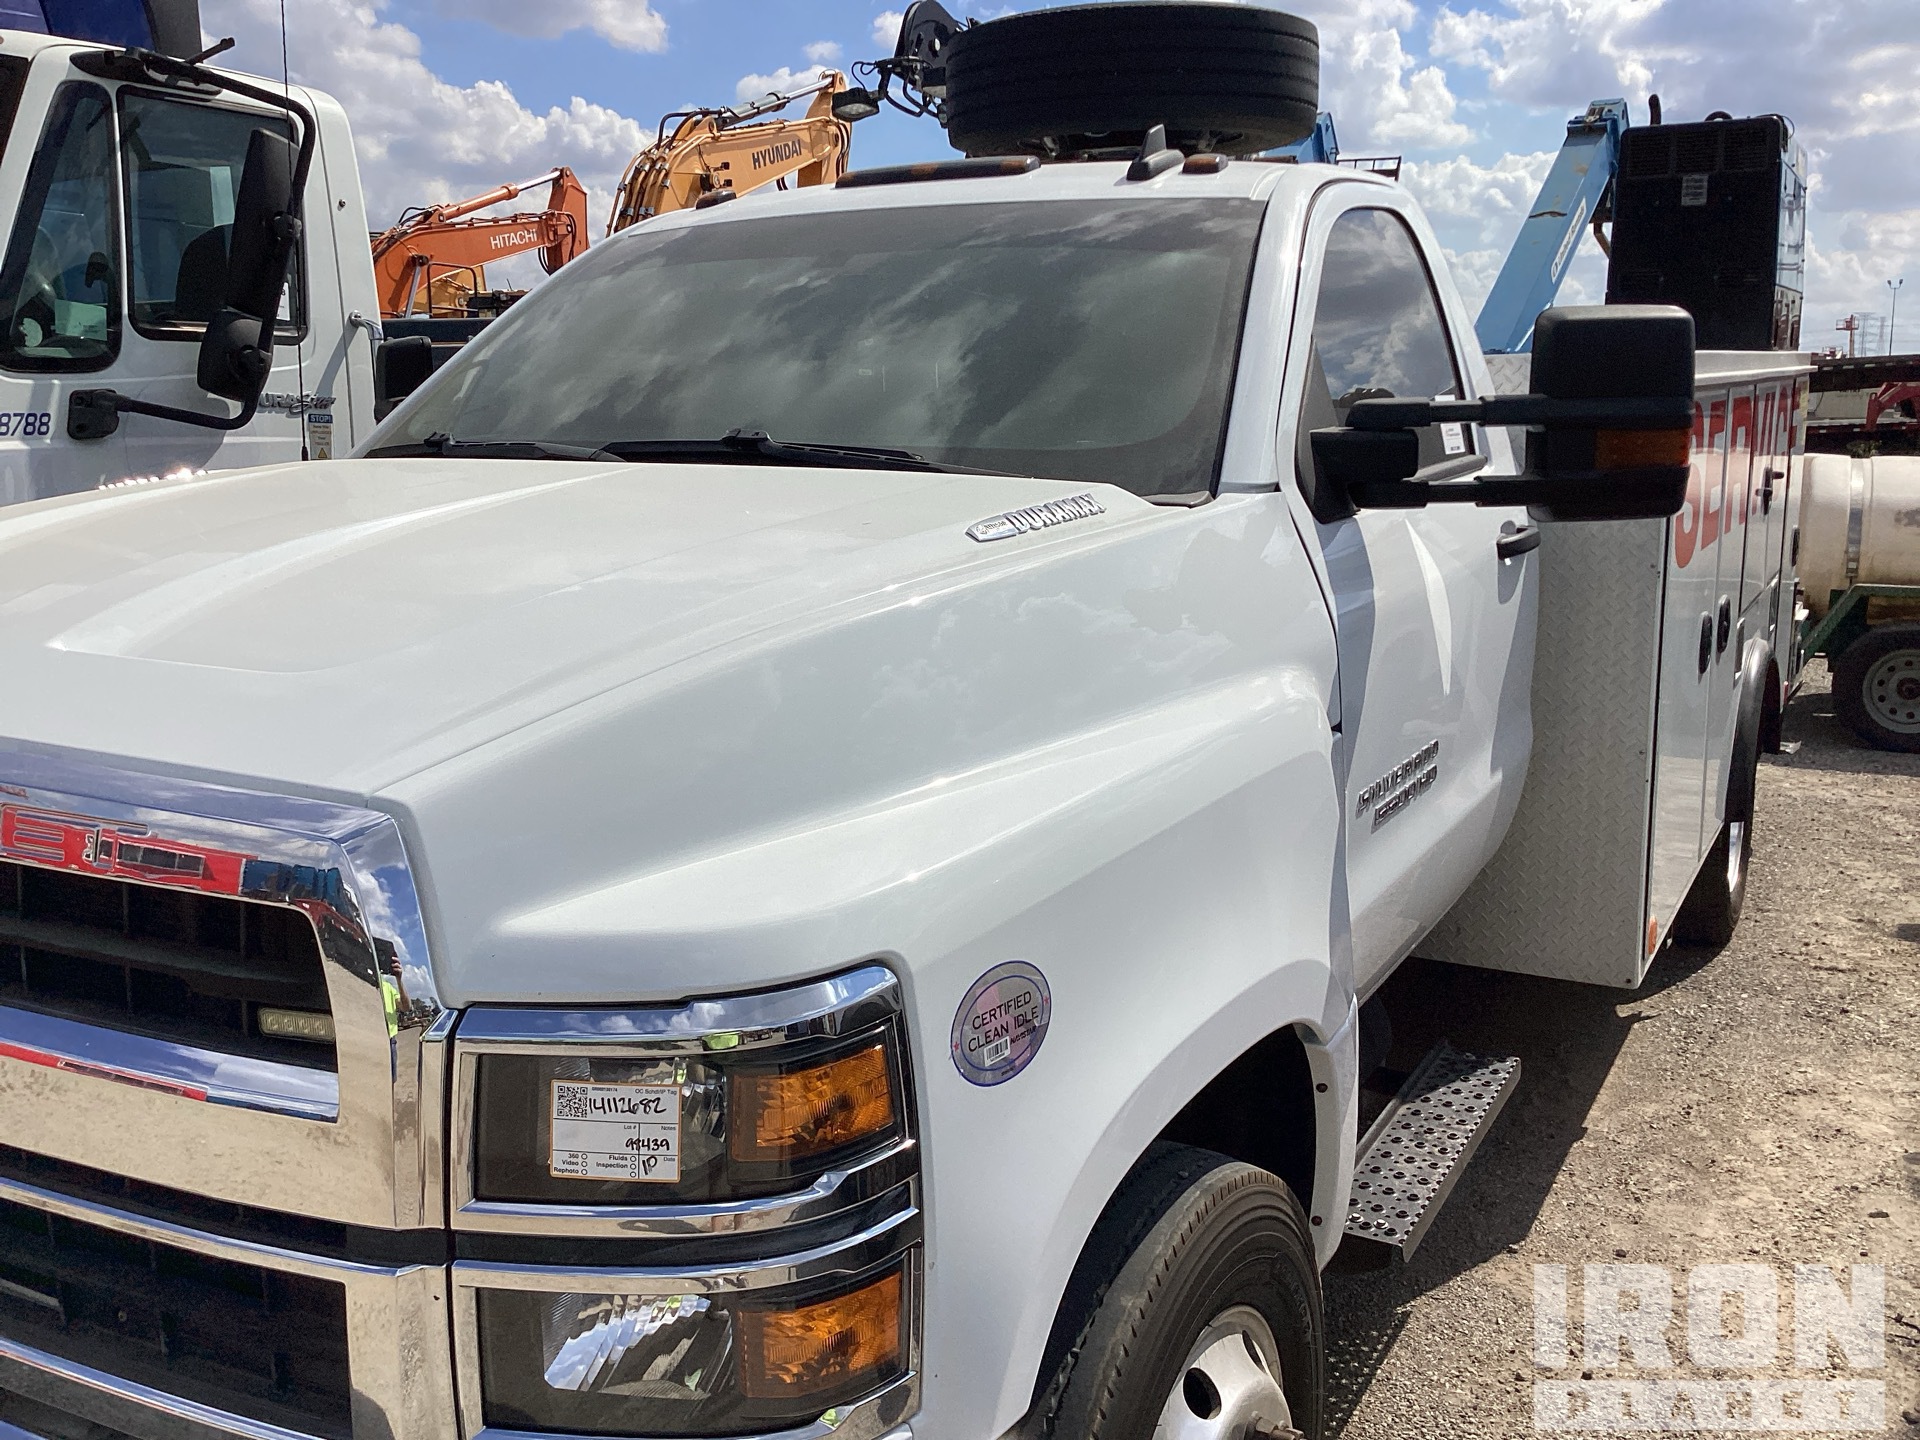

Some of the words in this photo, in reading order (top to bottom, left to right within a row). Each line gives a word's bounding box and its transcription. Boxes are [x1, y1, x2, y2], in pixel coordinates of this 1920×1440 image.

[752, 139, 802, 170] HYUNDAI
[490, 229, 537, 249] HITACHI
[1003, 492, 1107, 534] DURAMAX
[972, 990, 1032, 1030] CERTIFIED
[968, 1020, 1009, 1052] CLEAN
[1013, 1005, 1039, 1029] IDLE
[588, 1097, 667, 1115] 14112682
